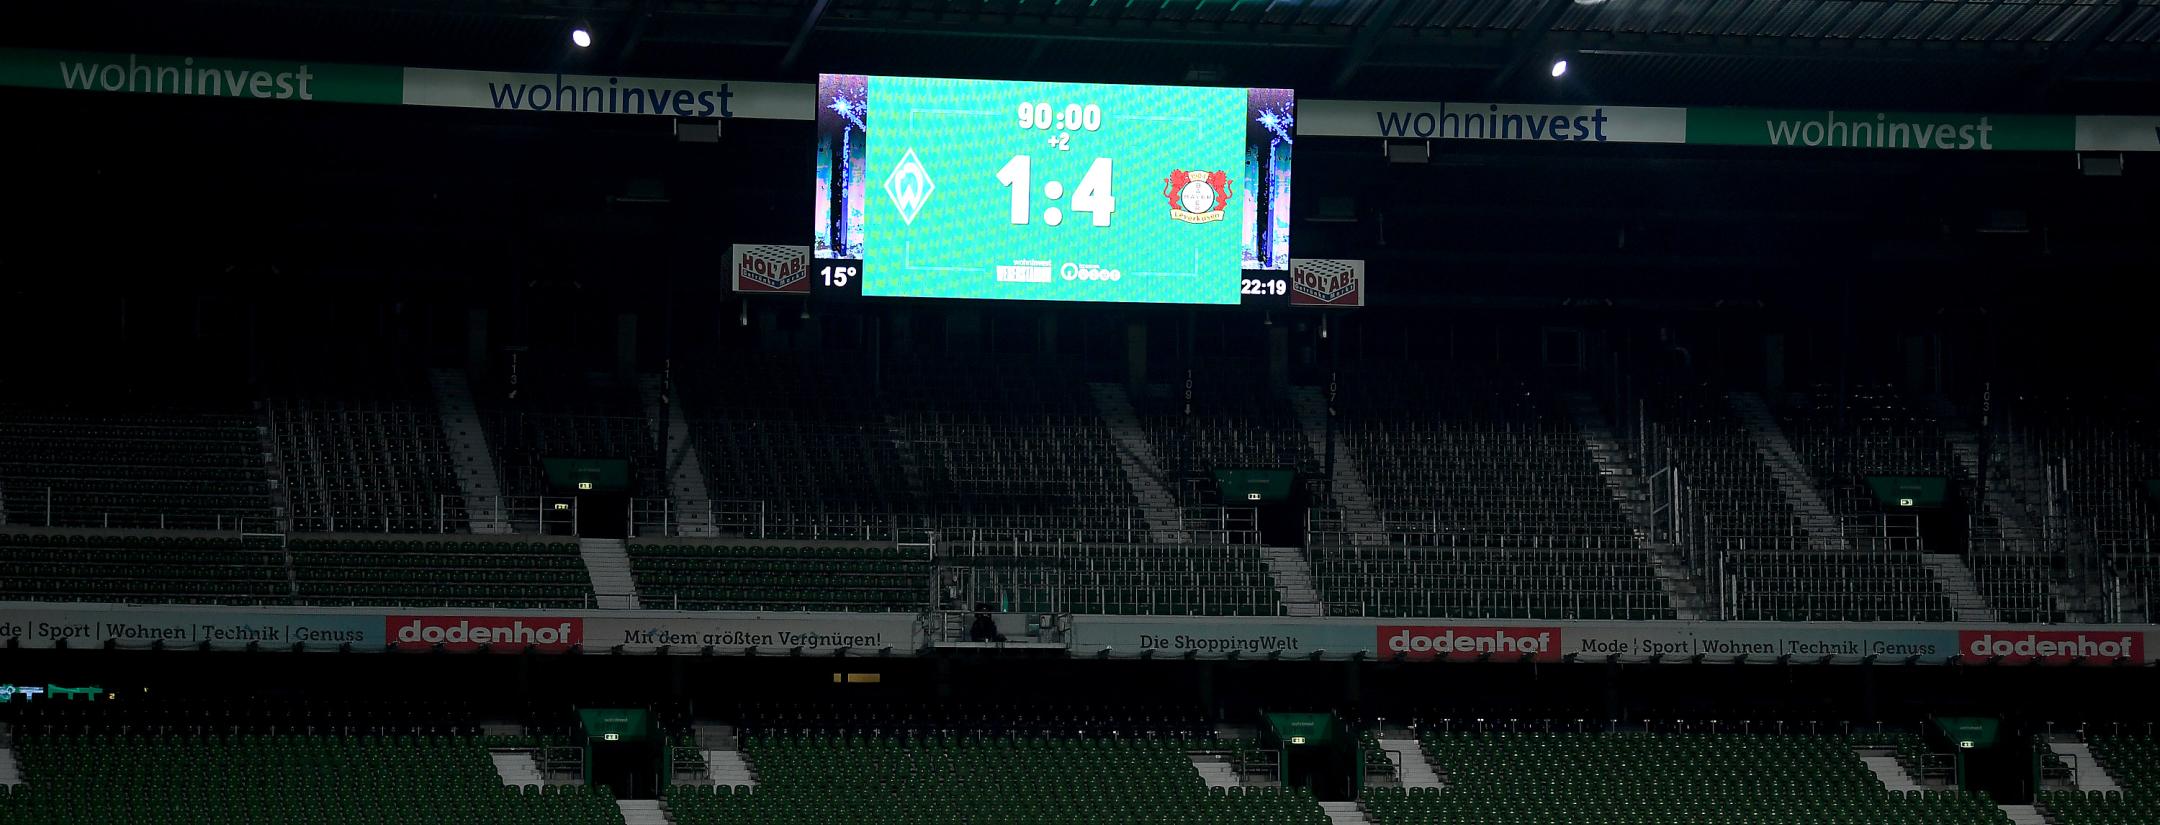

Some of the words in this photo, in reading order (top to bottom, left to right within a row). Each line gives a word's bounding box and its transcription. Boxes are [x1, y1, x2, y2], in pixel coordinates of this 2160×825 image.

[60, 53, 312, 100] wohninvest
[489, 73, 733, 117] wohninvest
[1018, 101, 1101, 131] 90:00
[1377, 98, 1607, 142] wohninvest
[1047, 132, 1070, 151] +2
[1766, 110, 1993, 150] wohninvest
[995, 154, 1115, 227] 1:4
[820, 266, 857, 287] 15°
[1241, 279, 1287, 295] 22:19
[39, 623, 90, 640] Sport
[106, 623, 186, 640] Wohnen
[202, 624, 279, 641] Technik
[295, 626, 364, 642] Genuss
[398, 619, 571, 644] dodenhof
[624, 630, 652, 645] Mit
[659, 629, 697, 645] dem
[703, 631, 773, 647] größten
[778, 631, 881, 648] Vergnügen!
[1388, 629, 1549, 653] dodenhof
[1140, 635, 1169, 649] Die
[1174, 635, 1298, 652] ShoppingWelt
[1582, 639, 1628, 653] Mode
[1643, 639, 1688, 656] Sport
[1703, 639, 1773, 654] Wohnen
[1788, 639, 1858, 655] Technik
[1873, 641, 1936, 655] Genuss
[1970, 634, 2132, 657] dodenhof
